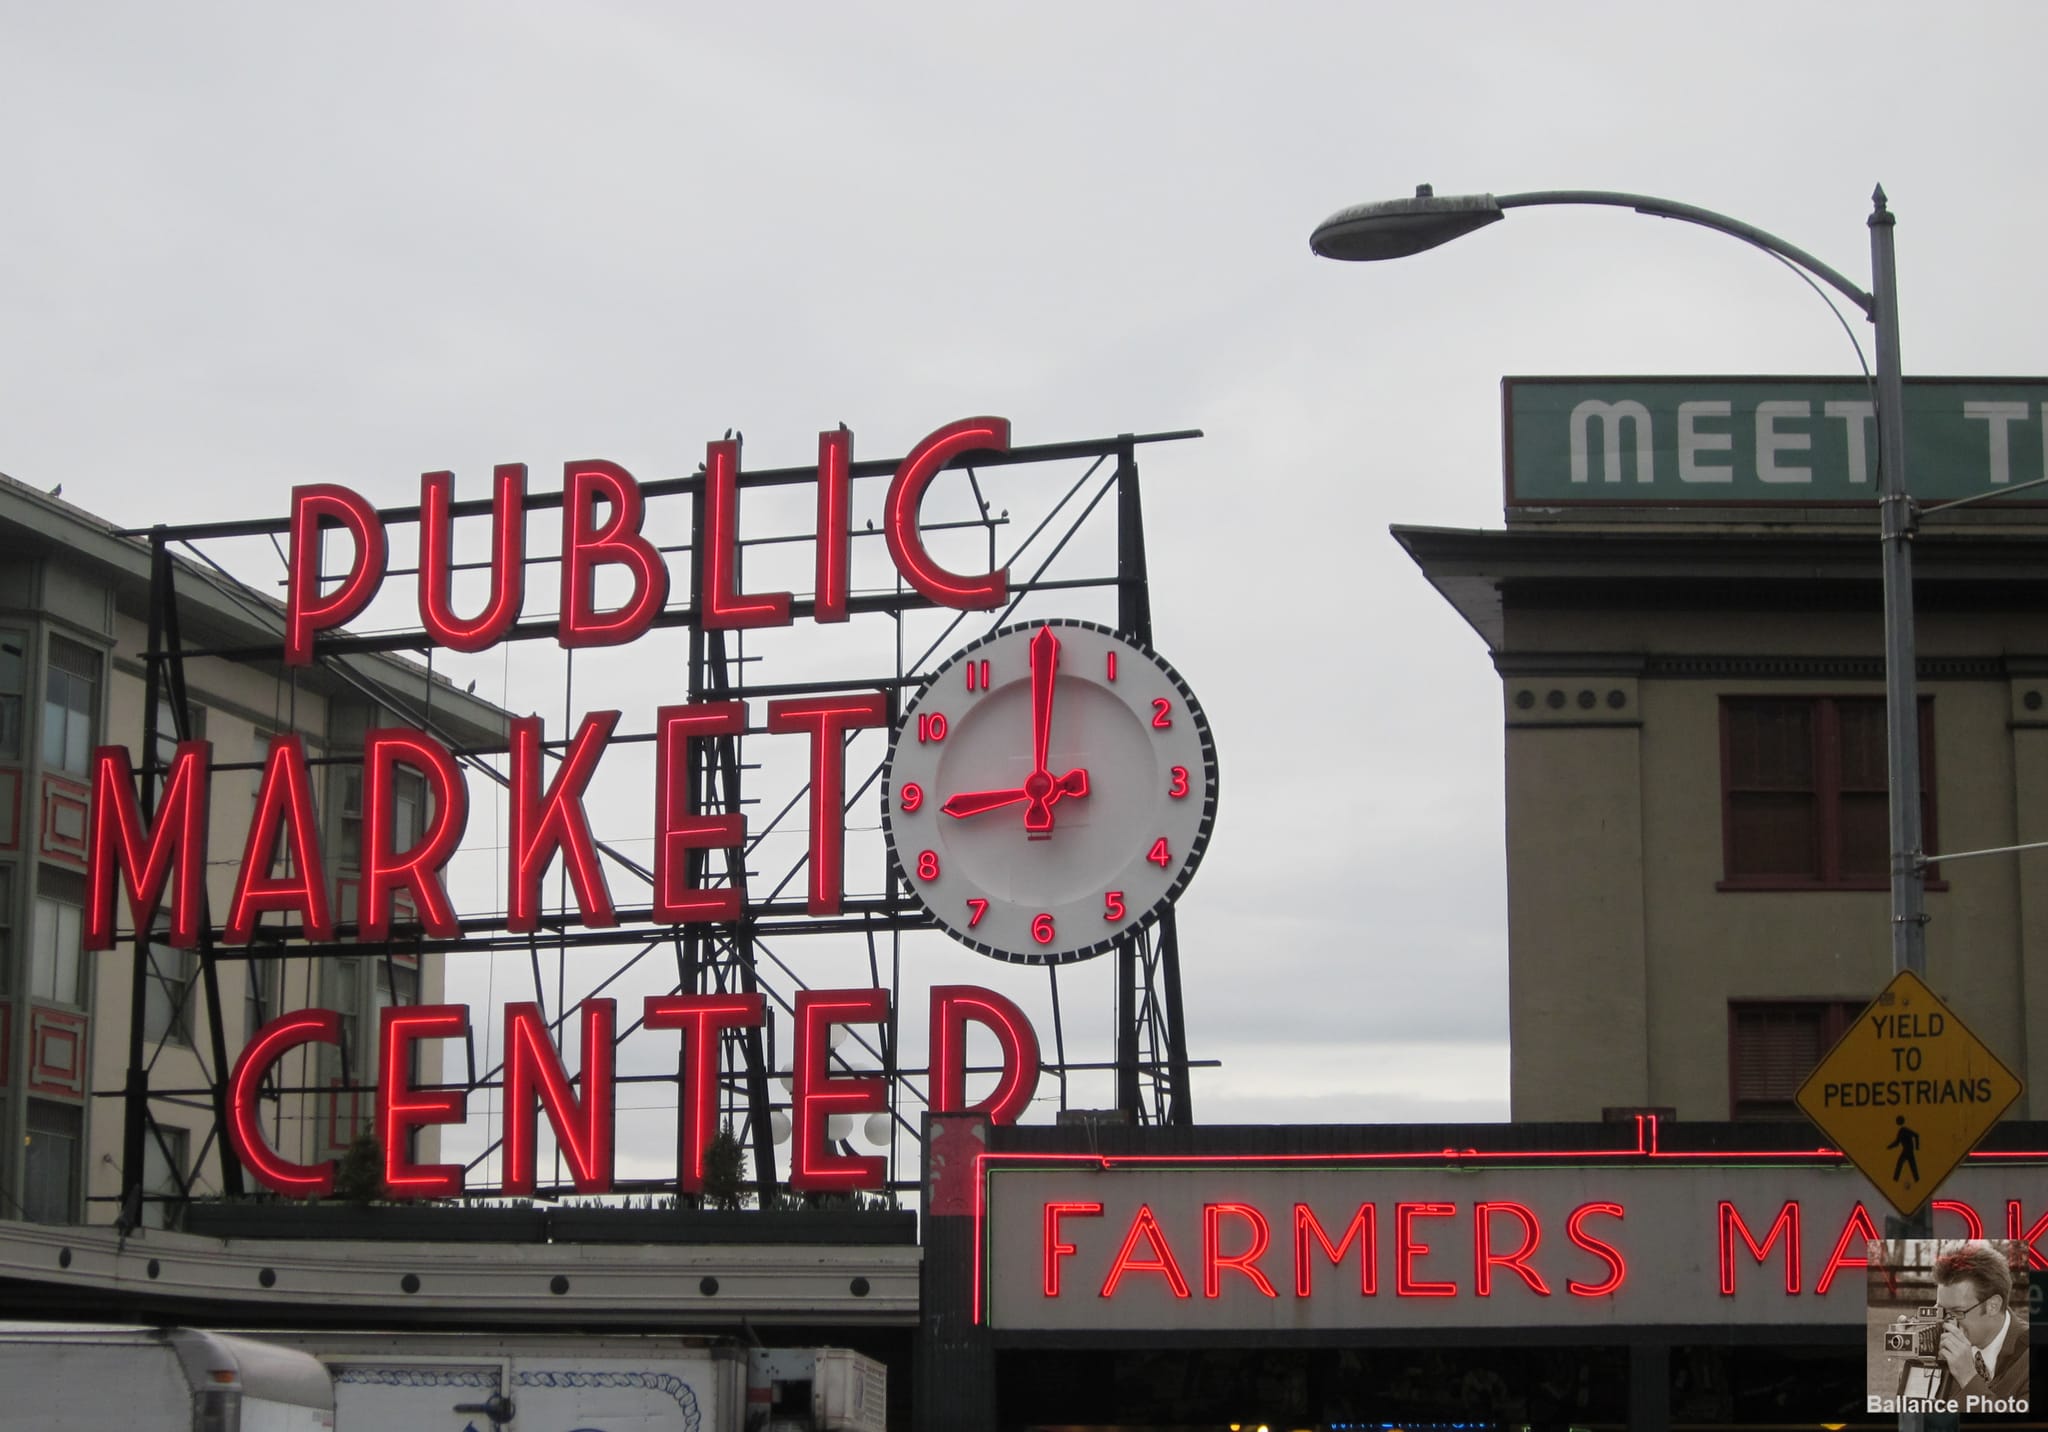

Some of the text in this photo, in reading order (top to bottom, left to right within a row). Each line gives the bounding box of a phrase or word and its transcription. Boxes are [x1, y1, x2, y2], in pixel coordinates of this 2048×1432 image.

[1569, 400, 2048, 483] MEET T
[284, 416, 1010, 666] PUBLIC
[965, 658, 991, 692] 11
[1106, 650, 1118, 682] 1
[917, 711, 949, 744] 10
[1151, 696, 1173, 729] 2
[900, 781, 925, 813] 9
[1168, 765, 1190, 799] 3
[84, 692, 888, 951] MARKET
[915, 849, 941, 882] 8
[1146, 836, 1172, 868] 4
[966, 897, 990, 928] 7
[1103, 890, 1127, 923] 5
[1030, 912, 1056, 945] 6
[1871, 1012, 1945, 1040] YIELD
[1892, 1046, 1923, 1073] TO
[226, 983, 1041, 1198] CENTER
[1823, 1076, 1993, 1109] PEDESTRIANS
[1042, 1200, 1628, 1298] FARMERS
